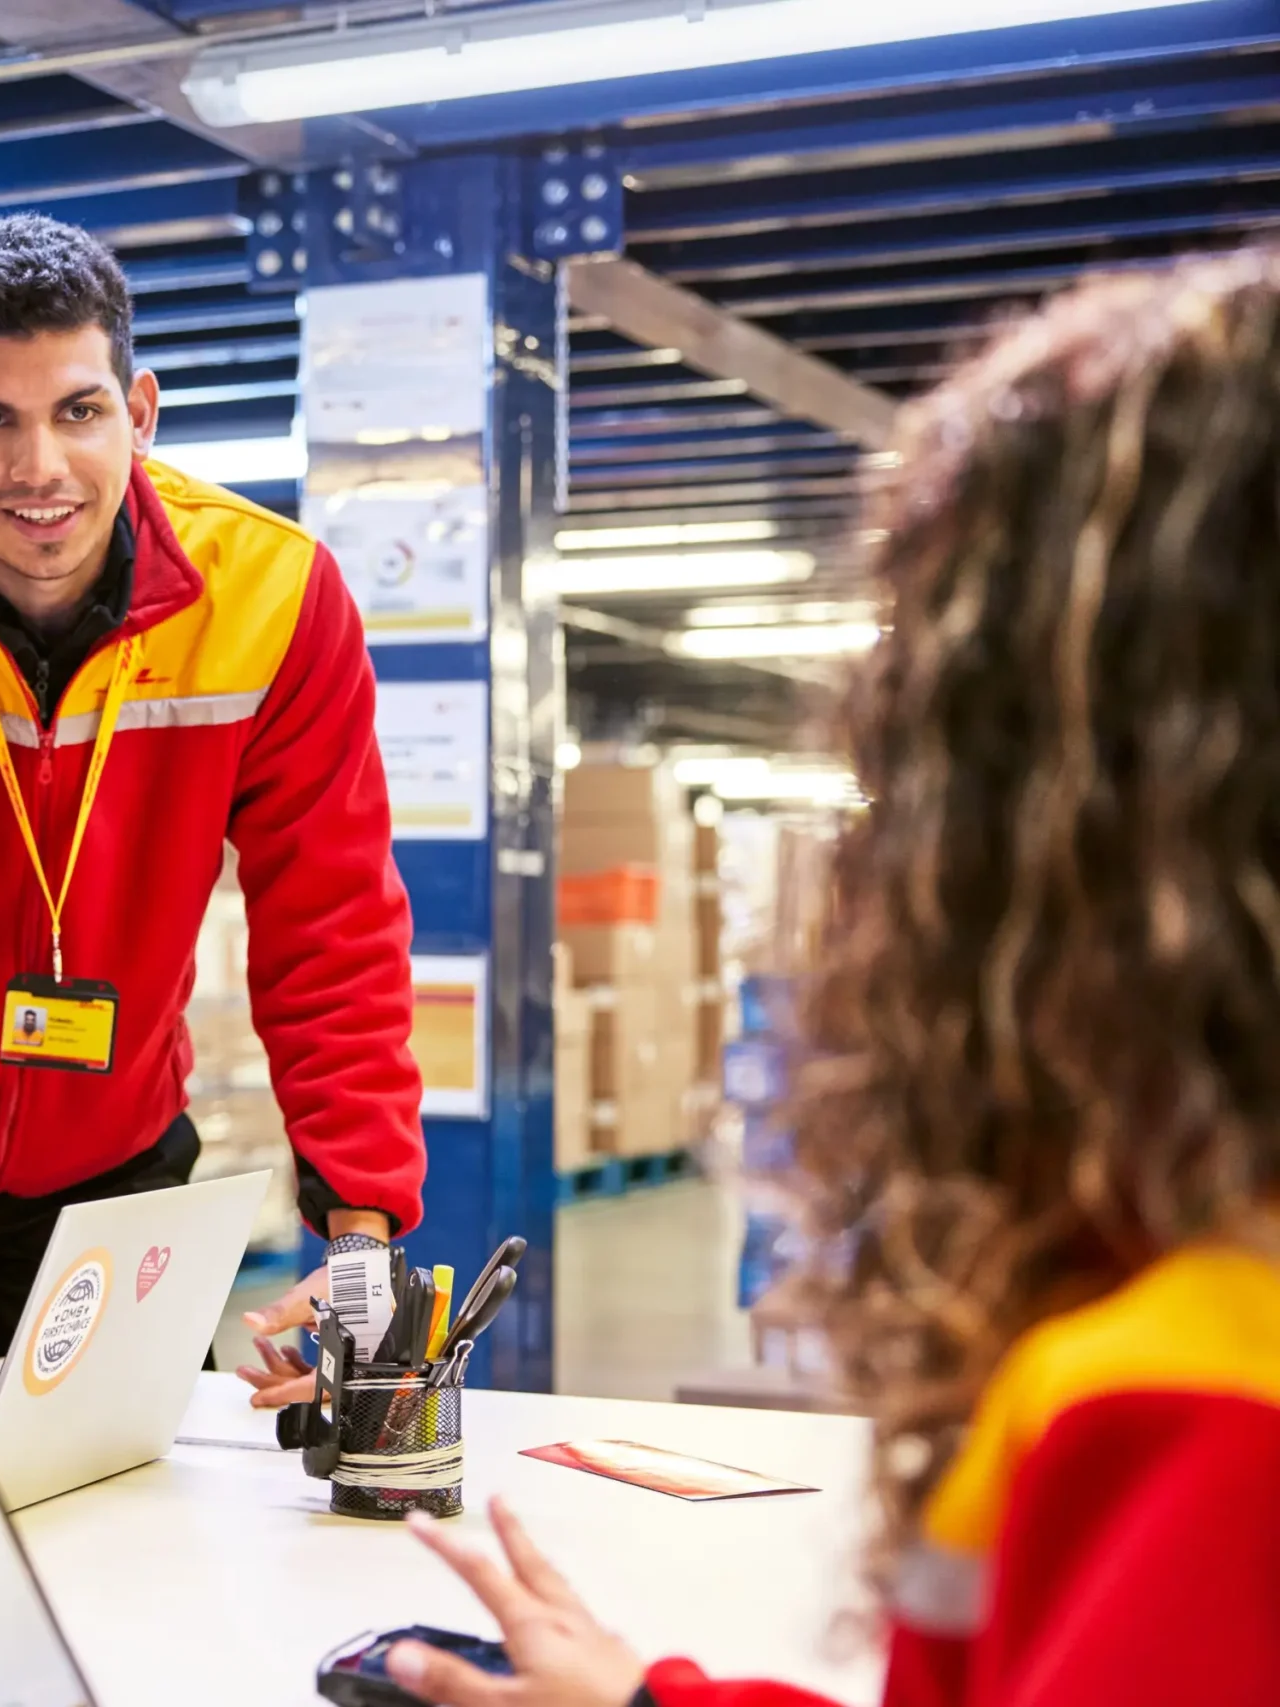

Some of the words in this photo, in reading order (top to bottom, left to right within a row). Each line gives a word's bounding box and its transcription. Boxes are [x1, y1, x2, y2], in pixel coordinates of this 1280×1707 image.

[372, 1283, 382, 1297] F1
[42, 1324, 65, 1339] FIRST
[63, 1316, 92, 1335] CHOICE
